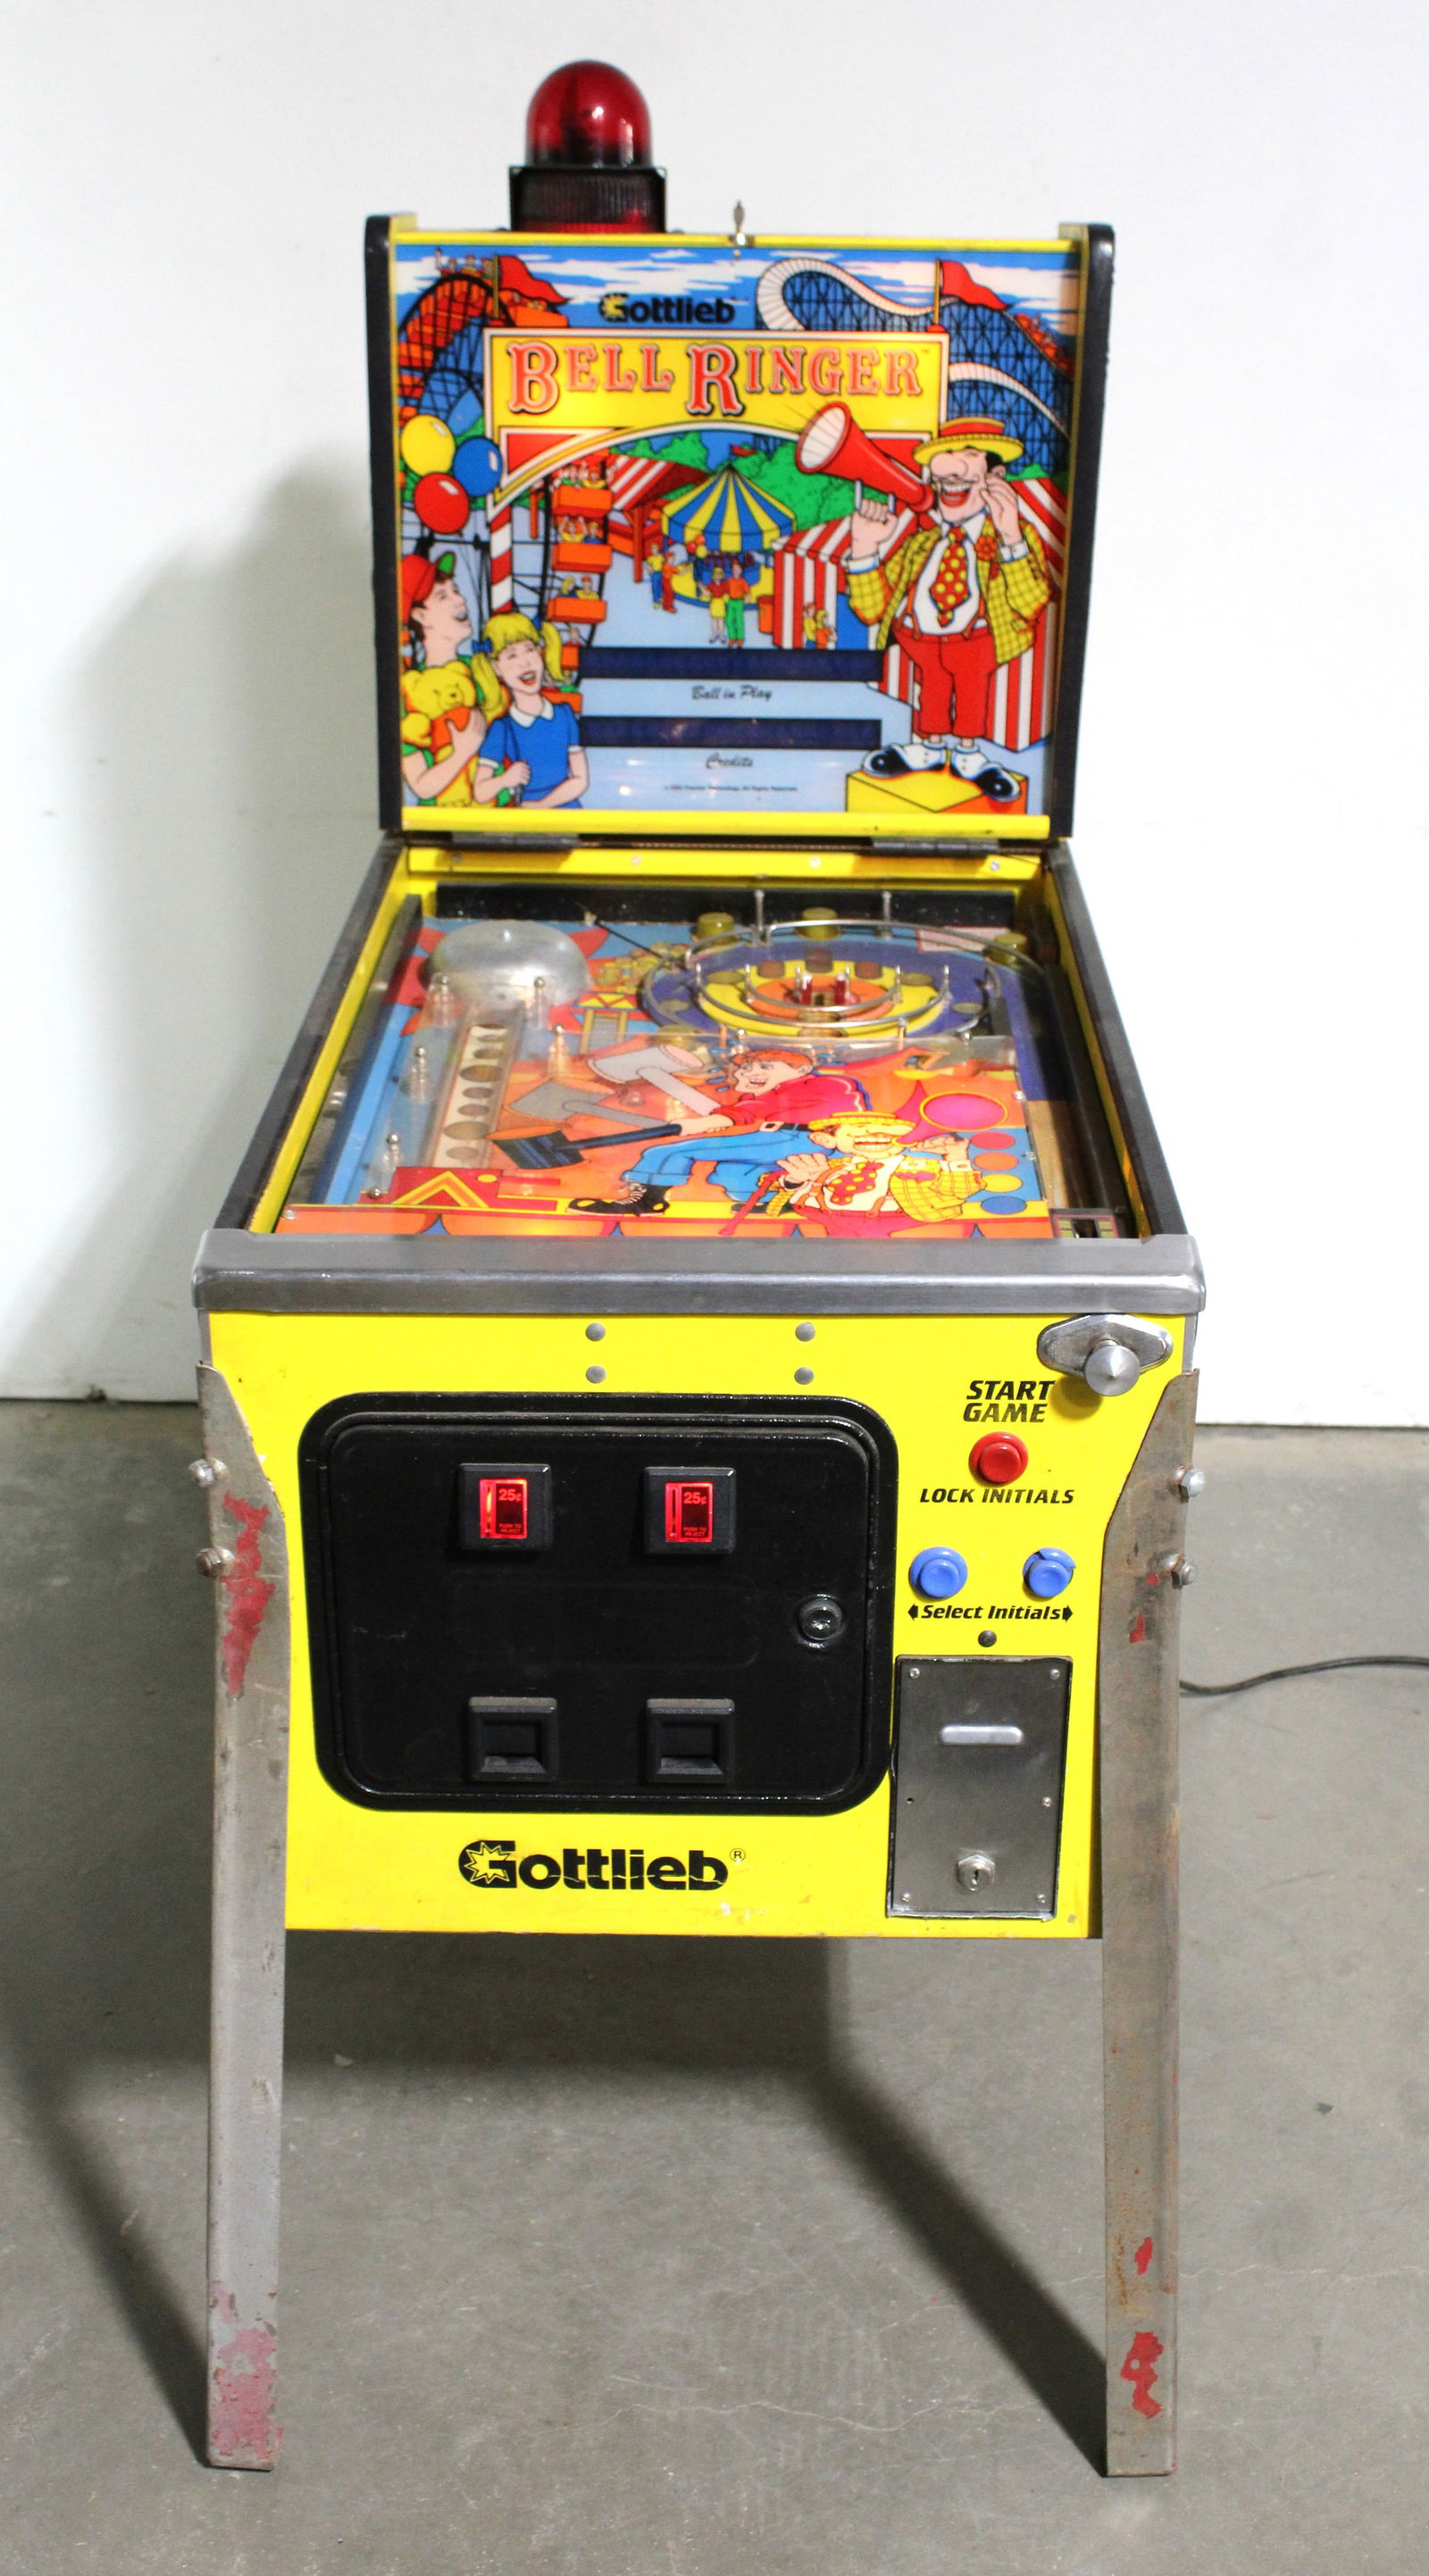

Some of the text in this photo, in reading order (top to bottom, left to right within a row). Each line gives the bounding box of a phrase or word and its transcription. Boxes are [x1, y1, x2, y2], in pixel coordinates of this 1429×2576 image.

[599, 293, 735, 323] Gottlieb
[506, 340, 923, 417] BELL RINGER
[691, 684, 773, 702] Ball in Play
[706, 752, 754, 770] Credits
[966, 1380, 1056, 1401] START
[963, 1403, 1048, 1423] GAME
[498, 1488, 522, 1503] 25¢
[920, 1488, 1074, 1504] LOCK INITIALS
[921, 1605, 1060, 1621] Select Initials
